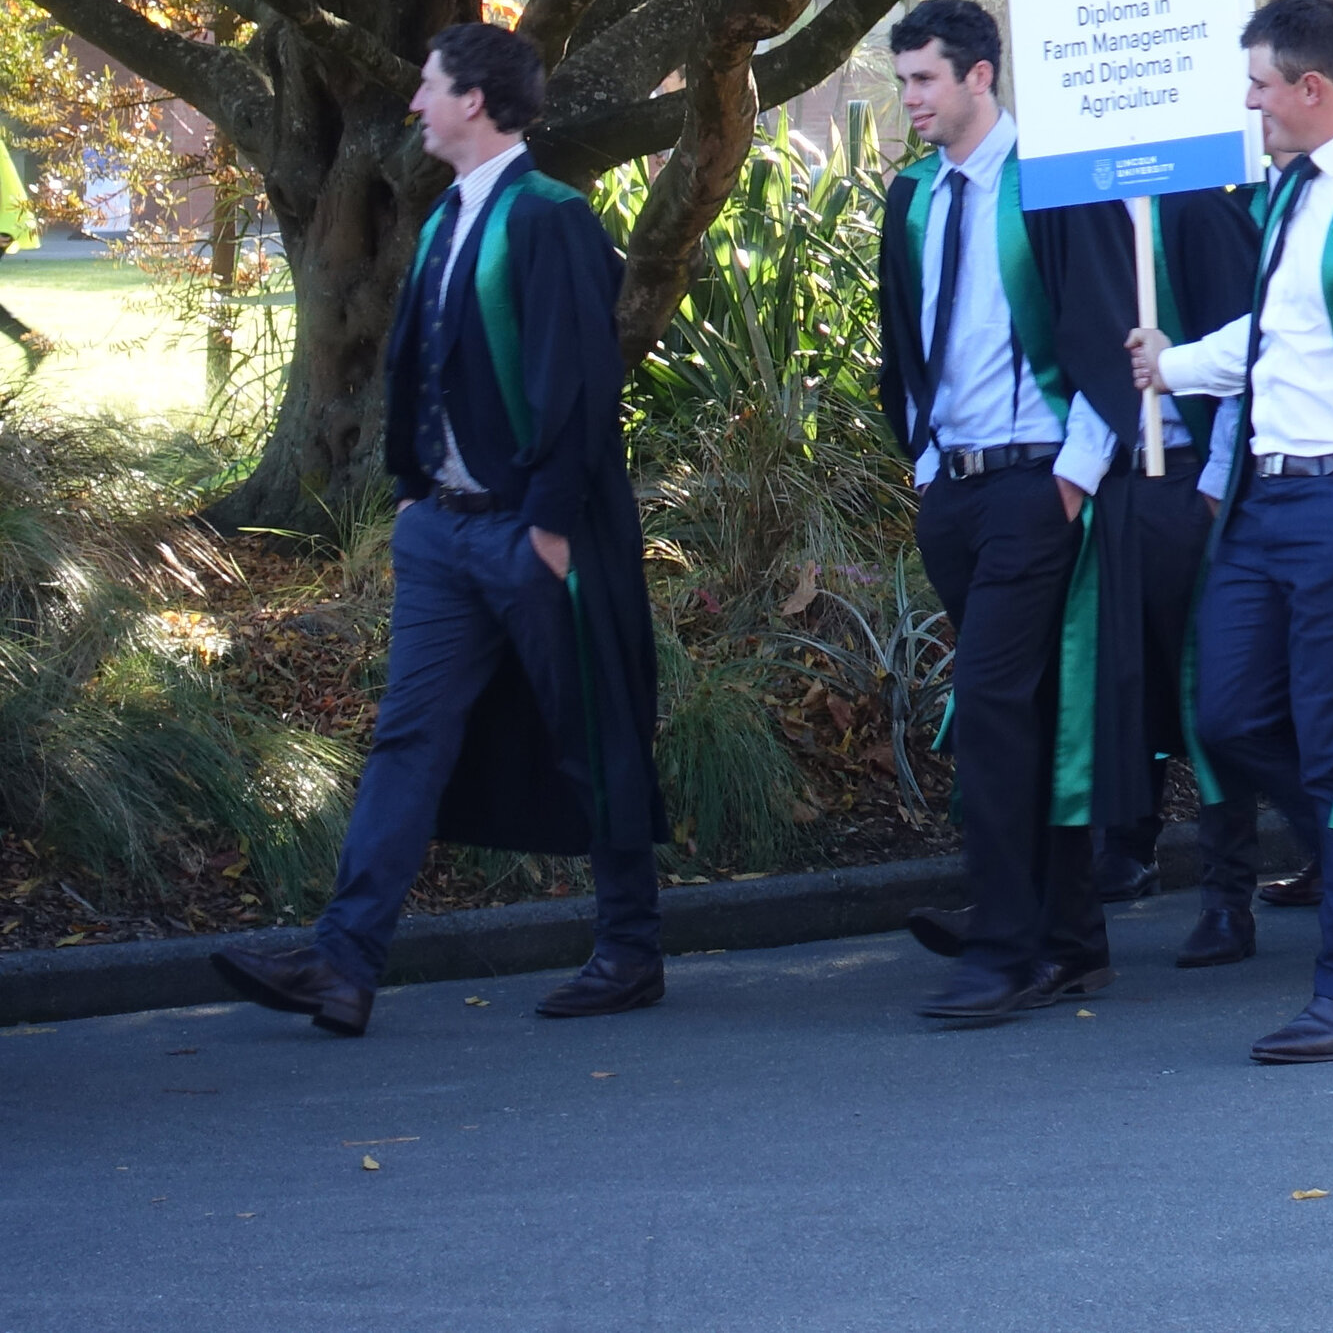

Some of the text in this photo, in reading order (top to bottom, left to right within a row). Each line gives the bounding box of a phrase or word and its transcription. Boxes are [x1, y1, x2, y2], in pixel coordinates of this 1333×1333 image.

[1077, 0, 1150, 28] Diploma
[1043, 20, 1208, 61] Farm Management
[1062, 51, 1193, 88] and Diploma in
[1080, 85, 1179, 118] Agriculture
